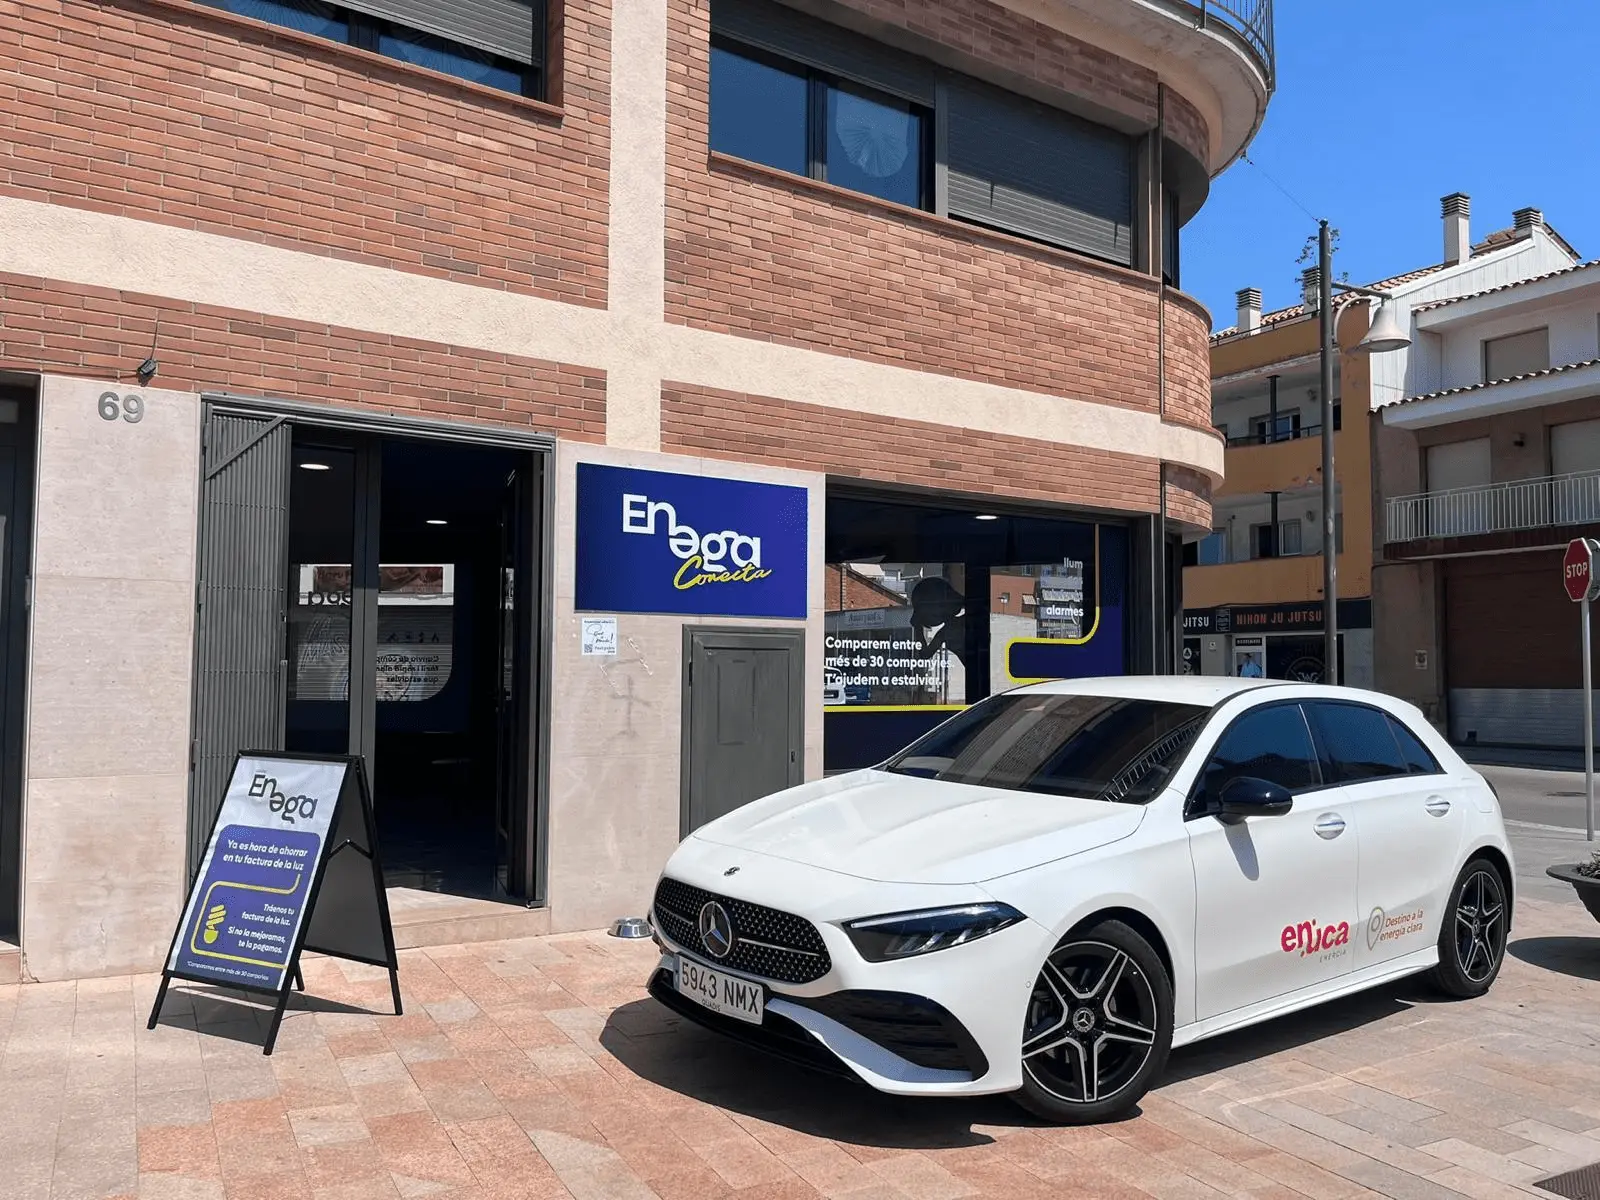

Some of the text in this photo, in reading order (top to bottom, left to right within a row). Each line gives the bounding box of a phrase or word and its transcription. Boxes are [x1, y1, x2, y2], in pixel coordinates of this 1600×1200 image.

[98, 391, 144, 423] 69
[1063, 557, 1083, 569] llum
[1566, 562, 1588, 579] STOP
[673, 555, 772, 590] Conecta
[1046, 604, 1084, 617] alarmes
[1236, 612, 1267, 625] NIHON
[1271, 611, 1284, 624] JU
[1288, 610, 1322, 623] JUTSU
[1183, 616, 1209, 628] JITSU
[825, 636, 923, 651] Comparem entre
[825, 655, 850, 667] més
[852, 655, 867, 667] de
[869, 655, 884, 667] 30
[825, 673, 943, 689] T'ajudem a estalviar.
[227, 839, 309, 857] Ya es hora de ahorrar
[223, 854, 304, 871] en tu factura de la luz
[241, 911, 265, 922] factura
[265, 914, 274, 923] de
[274, 915, 280, 924] la
[287, 907, 295, 915] tu
[1385, 913, 1411, 927] Destino
[1417, 909, 1424, 919] la
[227, 926, 235, 934] Si
[243, 928, 250, 937] la
[1407, 922, 1423, 933] clara
[245, 940, 252, 948] la
[1280, 918, 1349, 957] enica
[682, 962, 759, 1014] 5943 NMX
